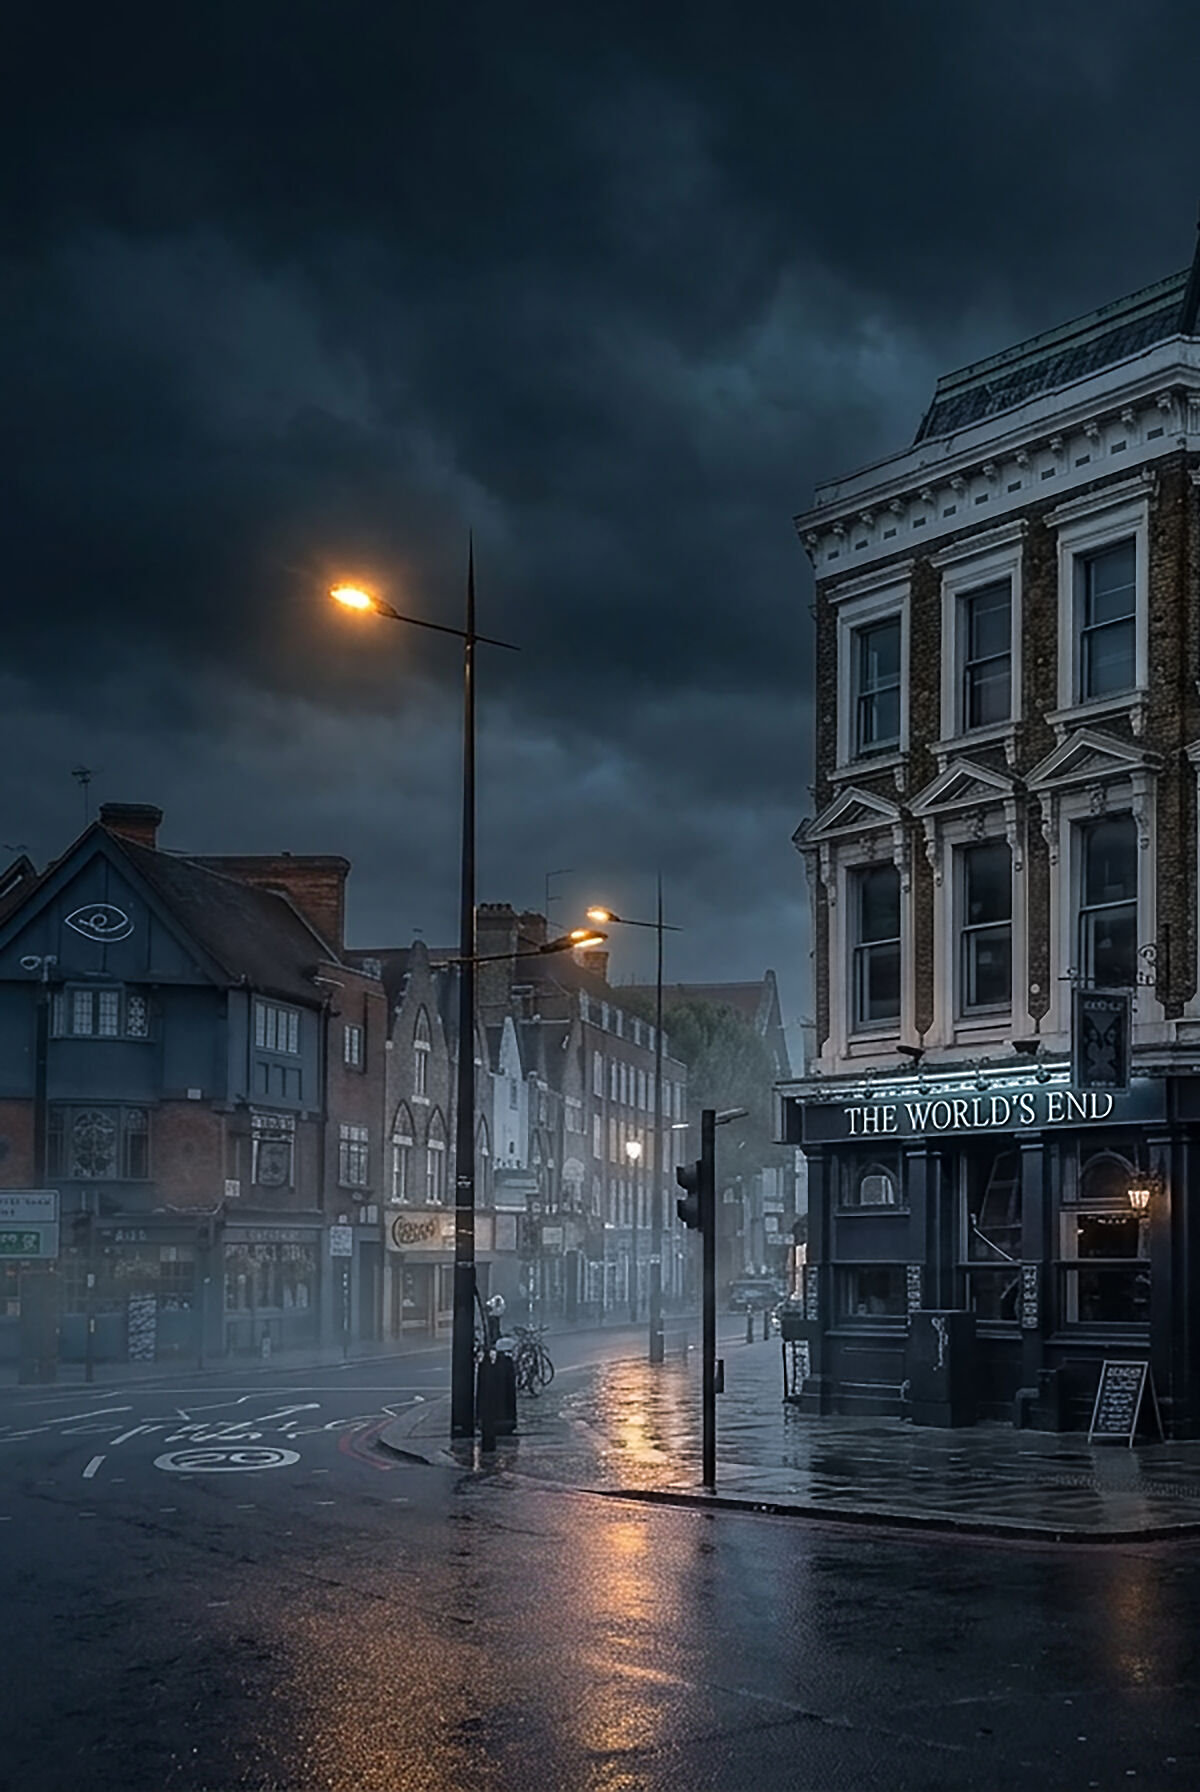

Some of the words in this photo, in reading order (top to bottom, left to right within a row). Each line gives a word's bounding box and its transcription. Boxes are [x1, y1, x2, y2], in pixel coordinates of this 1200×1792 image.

[844, 1105, 898, 1136] THE
[904, 1093, 1036, 1131] WORLD'S
[1047, 1091, 1113, 1122] END
